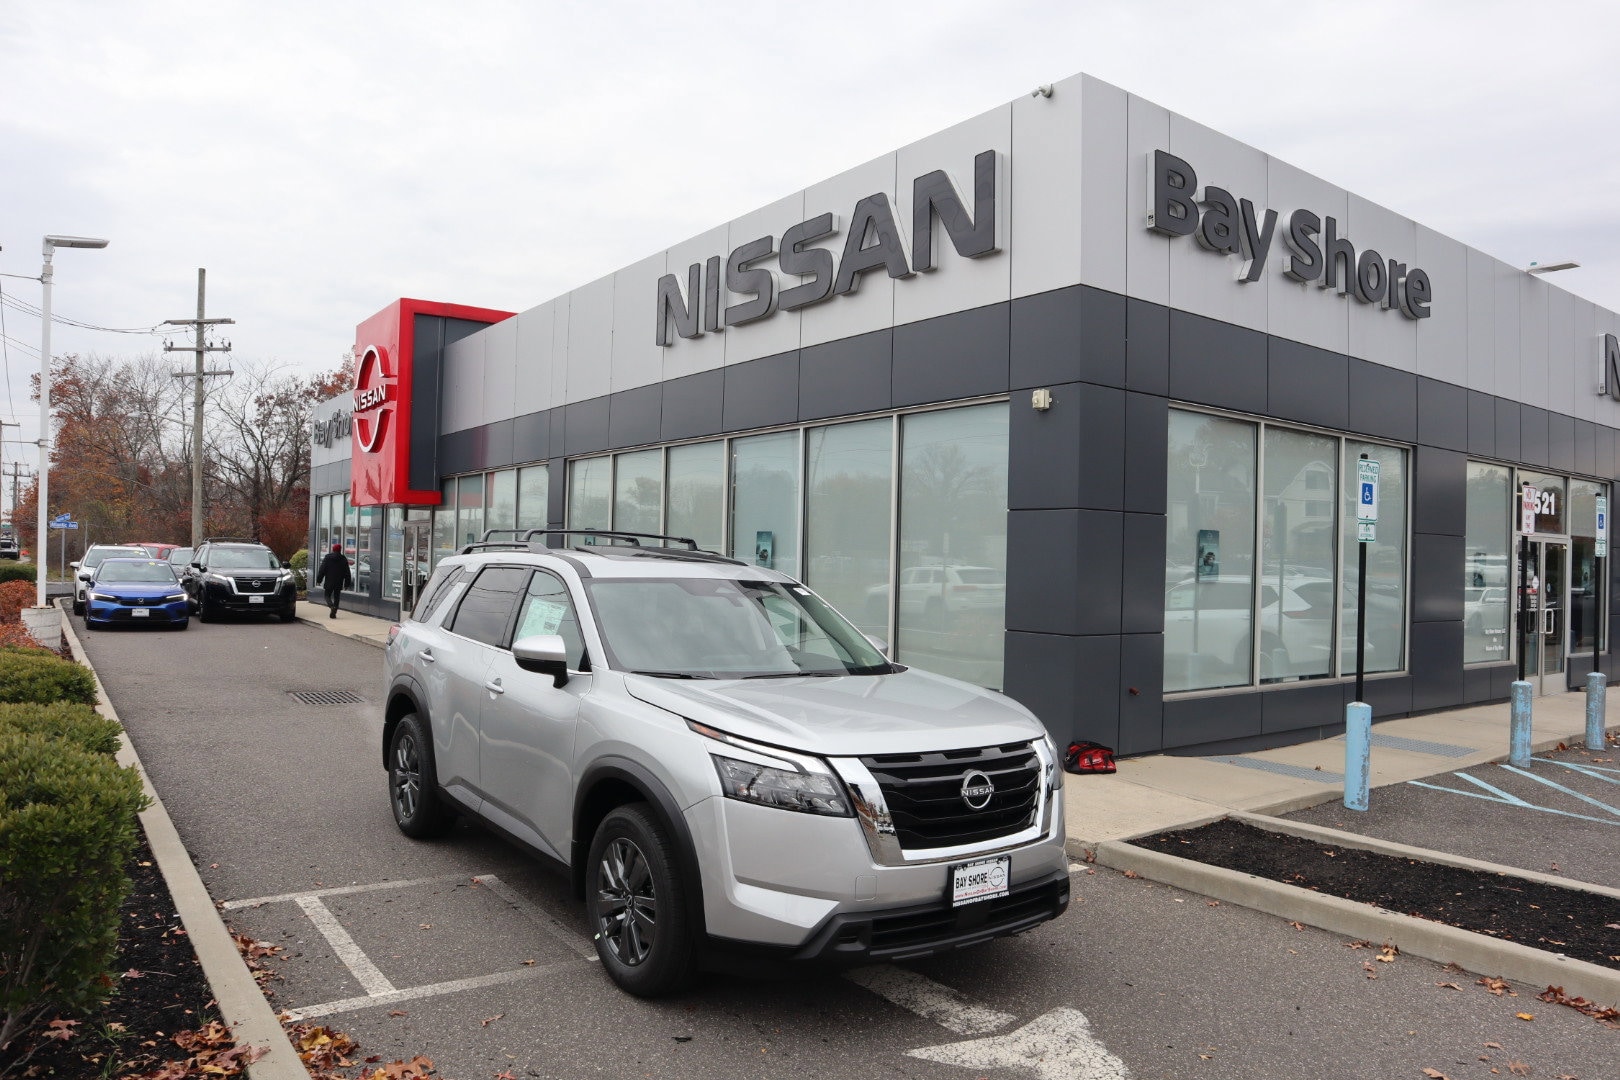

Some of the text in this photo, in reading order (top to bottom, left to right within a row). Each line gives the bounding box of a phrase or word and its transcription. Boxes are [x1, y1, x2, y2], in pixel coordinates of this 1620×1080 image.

[1149, 149, 1432, 319] Bay Shore
[655, 149, 1001, 347] NISSAN
[353, 384, 386, 411] NISSAN
[314, 419, 333, 448] Bay
[1360, 473, 1376, 483] PARKING
[961, 786, 994, 797] NISSAN
[955, 876, 968, 889] BAY
[968, 872, 988, 887] SHORE
